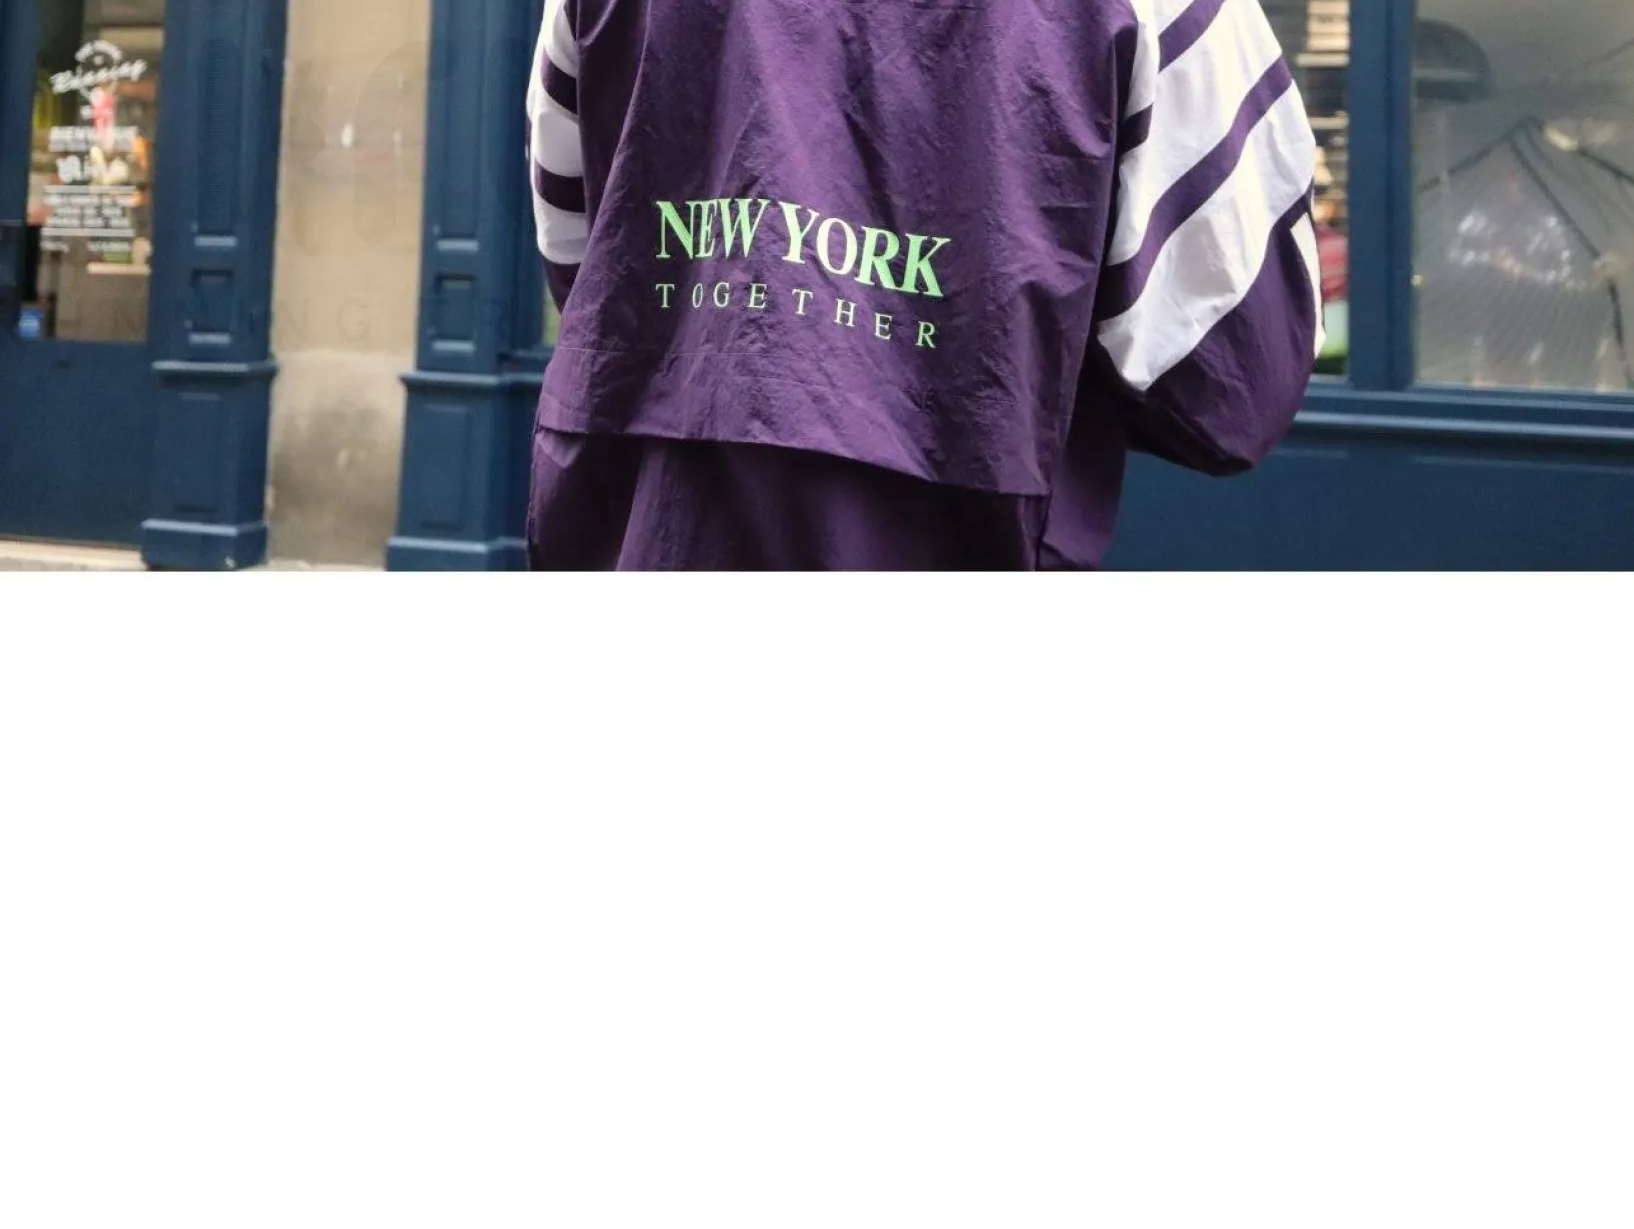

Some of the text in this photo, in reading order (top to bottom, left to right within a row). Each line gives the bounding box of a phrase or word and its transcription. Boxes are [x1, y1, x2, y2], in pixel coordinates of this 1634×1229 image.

[655, 198, 952, 297] NEW YORK
[655, 282, 938, 349] TOGETHER
